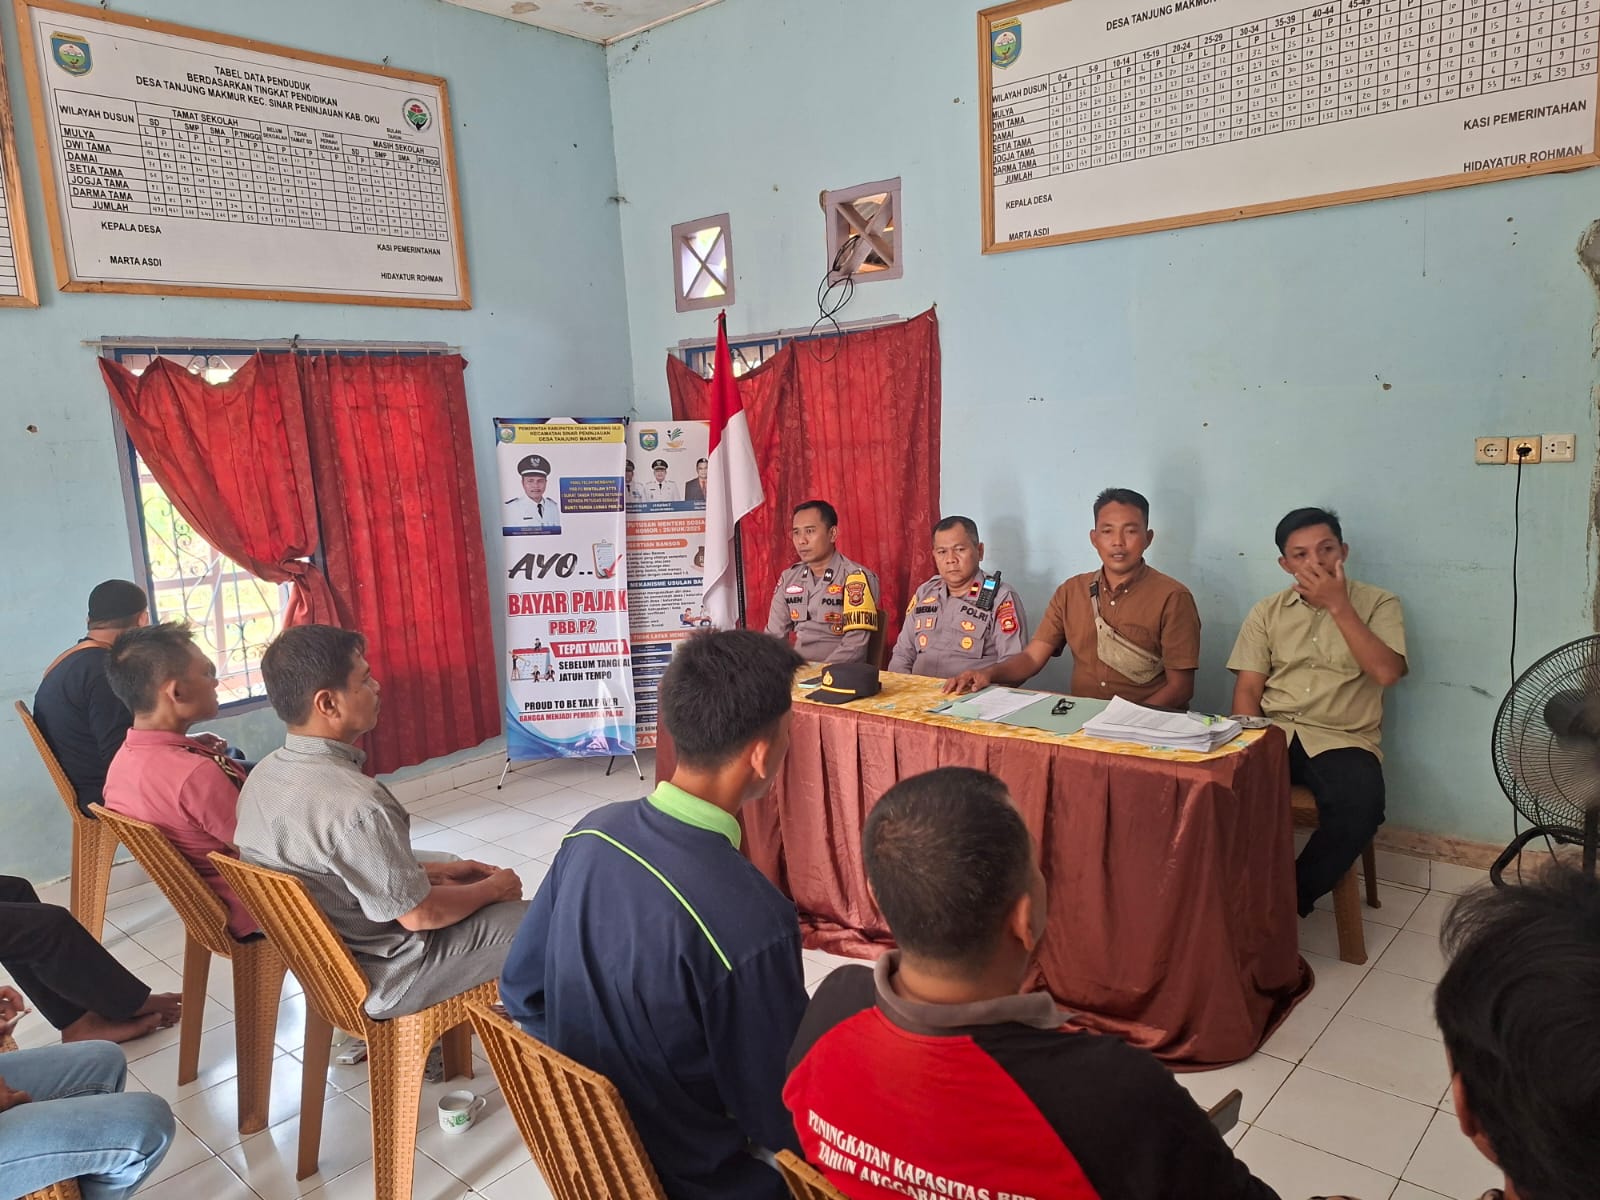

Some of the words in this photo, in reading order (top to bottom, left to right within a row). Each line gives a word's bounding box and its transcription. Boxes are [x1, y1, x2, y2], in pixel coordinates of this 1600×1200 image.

[1106, 16, 1130, 31] DESA
[1131, 4, 1173, 24] TANJUNG
[1312, 6, 1334, 18] 40-44
[1275, 16, 1296, 28] 35-39
[1240, 25, 1260, 36] 30-34
[1204, 34, 1223, 44] 25-29
[1172, 42, 1191, 52] 20-24
[1113, 58, 1130, 68] 10-14
[1058, 73, 1068, 81] 0-4
[1554, 67, 1567, 76] 39
[215, 66, 242, 80] TABEL
[244, 72, 266, 84] DATA
[266, 76, 312, 92] PENDUDUK
[187, 72, 252, 92] BERDASARKAN
[254, 84, 288, 99] TINGKAT
[291, 92, 338, 106] PENDIDIKAN
[992, 92, 1022, 103] WILAYAH
[1023, 83, 1048, 96] DUSUN
[136, 75, 162, 88] DESA
[163, 80, 206, 96] TANJUNG
[208, 88, 246, 102] MAKMUR
[248, 95, 268, 106] KEC.
[269, 98, 292, 111] SINAR
[296, 103, 343, 118] PENINJAUAN
[345, 110, 362, 122] KAB.
[364, 114, 380, 124] OKU
[59, 104, 102, 120] WILAYAH
[103, 112, 134, 124] DUSUN
[172, 108, 200, 122] TAMAT
[201, 113, 238, 126] SEKOLAH
[992, 107, 1014, 118] MULYA
[1464, 116, 1490, 130] KASI
[1493, 100, 1587, 126] PEMERINTAHAN
[149, 118, 160, 126] SD
[184, 123, 200, 132] SMP
[992, 121, 1004, 131] DWI
[1006, 116, 1025, 128] TAMA
[64, 128, 95, 140] MULYA
[210, 126, 226, 136] SMA
[992, 130, 1014, 142] DAMAI
[65, 139, 84, 150] DWI
[86, 141, 112, 154] TAMA
[373, 140, 395, 150] MASIH
[395, 144, 424, 154] SEKOLAH
[993, 141, 1012, 152] SETIA
[1013, 138, 1032, 148] TAMA
[67, 152, 98, 163] DAMAI
[993, 152, 1015, 164] JOGJA
[1017, 148, 1035, 159] TAMA
[1464, 153, 1526, 172] HIDAYATUR
[1530, 145, 1584, 162] ROHMAN
[70, 162, 99, 175] SETIA
[99, 166, 124, 178] TAMA
[993, 163, 1016, 175] DARMA
[1018, 159, 1037, 170] TAMA
[72, 175, 102, 188] JOGJA
[104, 178, 130, 190] TAMA
[1005, 171, 1033, 184] JUMLAH
[72, 186, 106, 199] DARMA
[108, 190, 134, 201] TAMA
[92, 200, 128, 212] JUMLAH
[1005, 197, 1032, 209] KEPALA
[1034, 194, 1053, 205] DESA
[101, 222, 137, 232] KEPALA
[138, 223, 162, 234] DESA
[1008, 229, 1031, 241] MARTA
[1032, 227, 1050, 237] ASDI
[377, 244, 393, 252] KASI
[394, 245, 441, 255] PEMERINTAHAN
[110, 255, 140, 266] MARTA
[141, 257, 162, 267] ASDI
[380, 272, 416, 282] HIDAYATUR
[416, 274, 443, 283] ROHMAN
[508, 592, 569, 616] BAYAR
[572, 590, 627, 613] PAJAK
[960, 606, 988, 622] POLRI
[548, 620, 597, 636] PBB.P2
[558, 643, 586, 654] TEPAT
[559, 660, 595, 670] SEBELUM
[597, 658, 630, 668] TANGAL
[559, 671, 584, 682] JATUH
[585, 670, 612, 680] TEMPO
[524, 700, 553, 711] PROUD
[554, 700, 565, 709] TO
[566, 699, 577, 708] BE
[578, 698, 593, 708] TAX
[545, 712, 572, 721] MENJADI
[808, 1109, 890, 1171] PENINGKATAN
[893, 1158, 990, 1200] KAPASITAS
[818, 1141, 856, 1175] TAHUN
